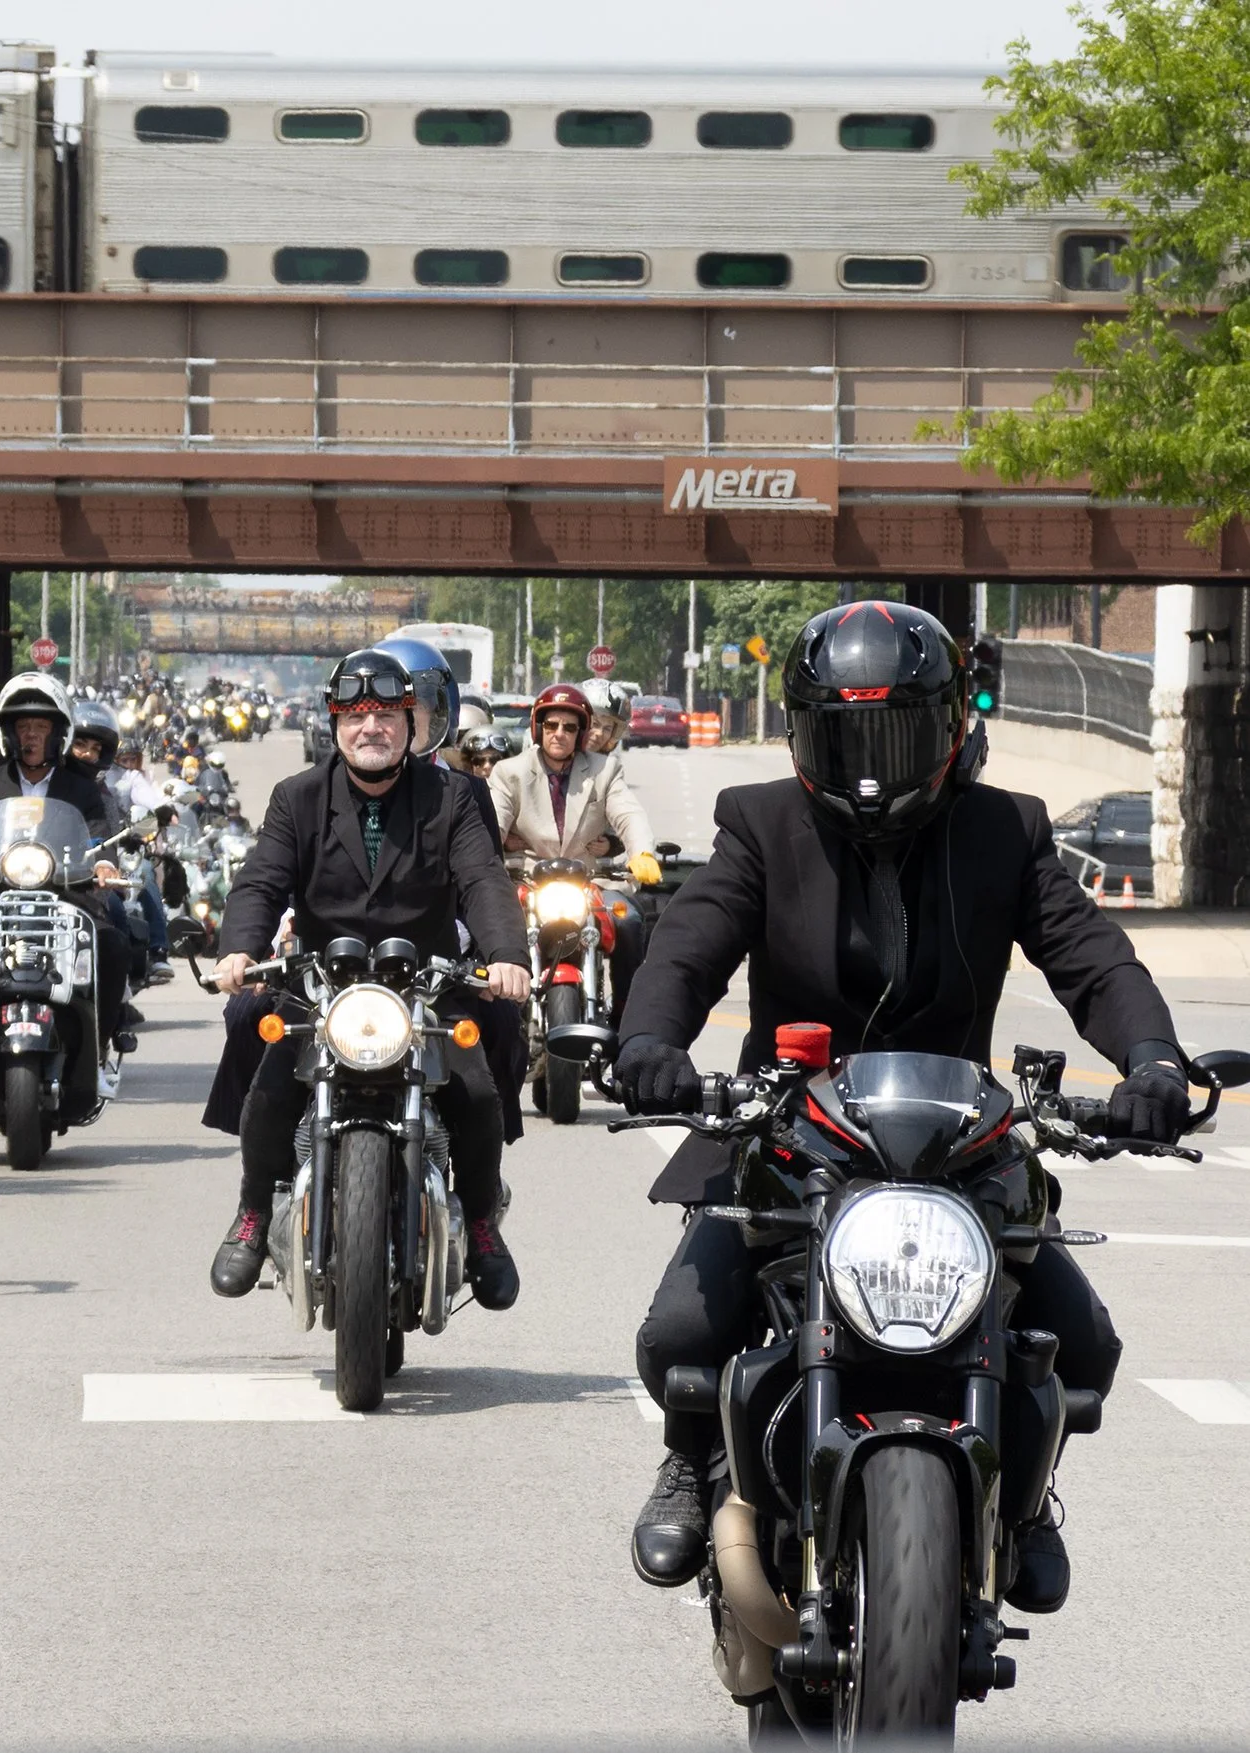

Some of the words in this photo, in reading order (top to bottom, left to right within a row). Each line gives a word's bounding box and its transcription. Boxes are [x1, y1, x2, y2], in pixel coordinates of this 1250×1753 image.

[670, 465, 796, 509] Metra
[33, 646, 56, 657] STOP
[591, 653, 615, 666] STOP
[1151, 1146, 1184, 1157] ASV
